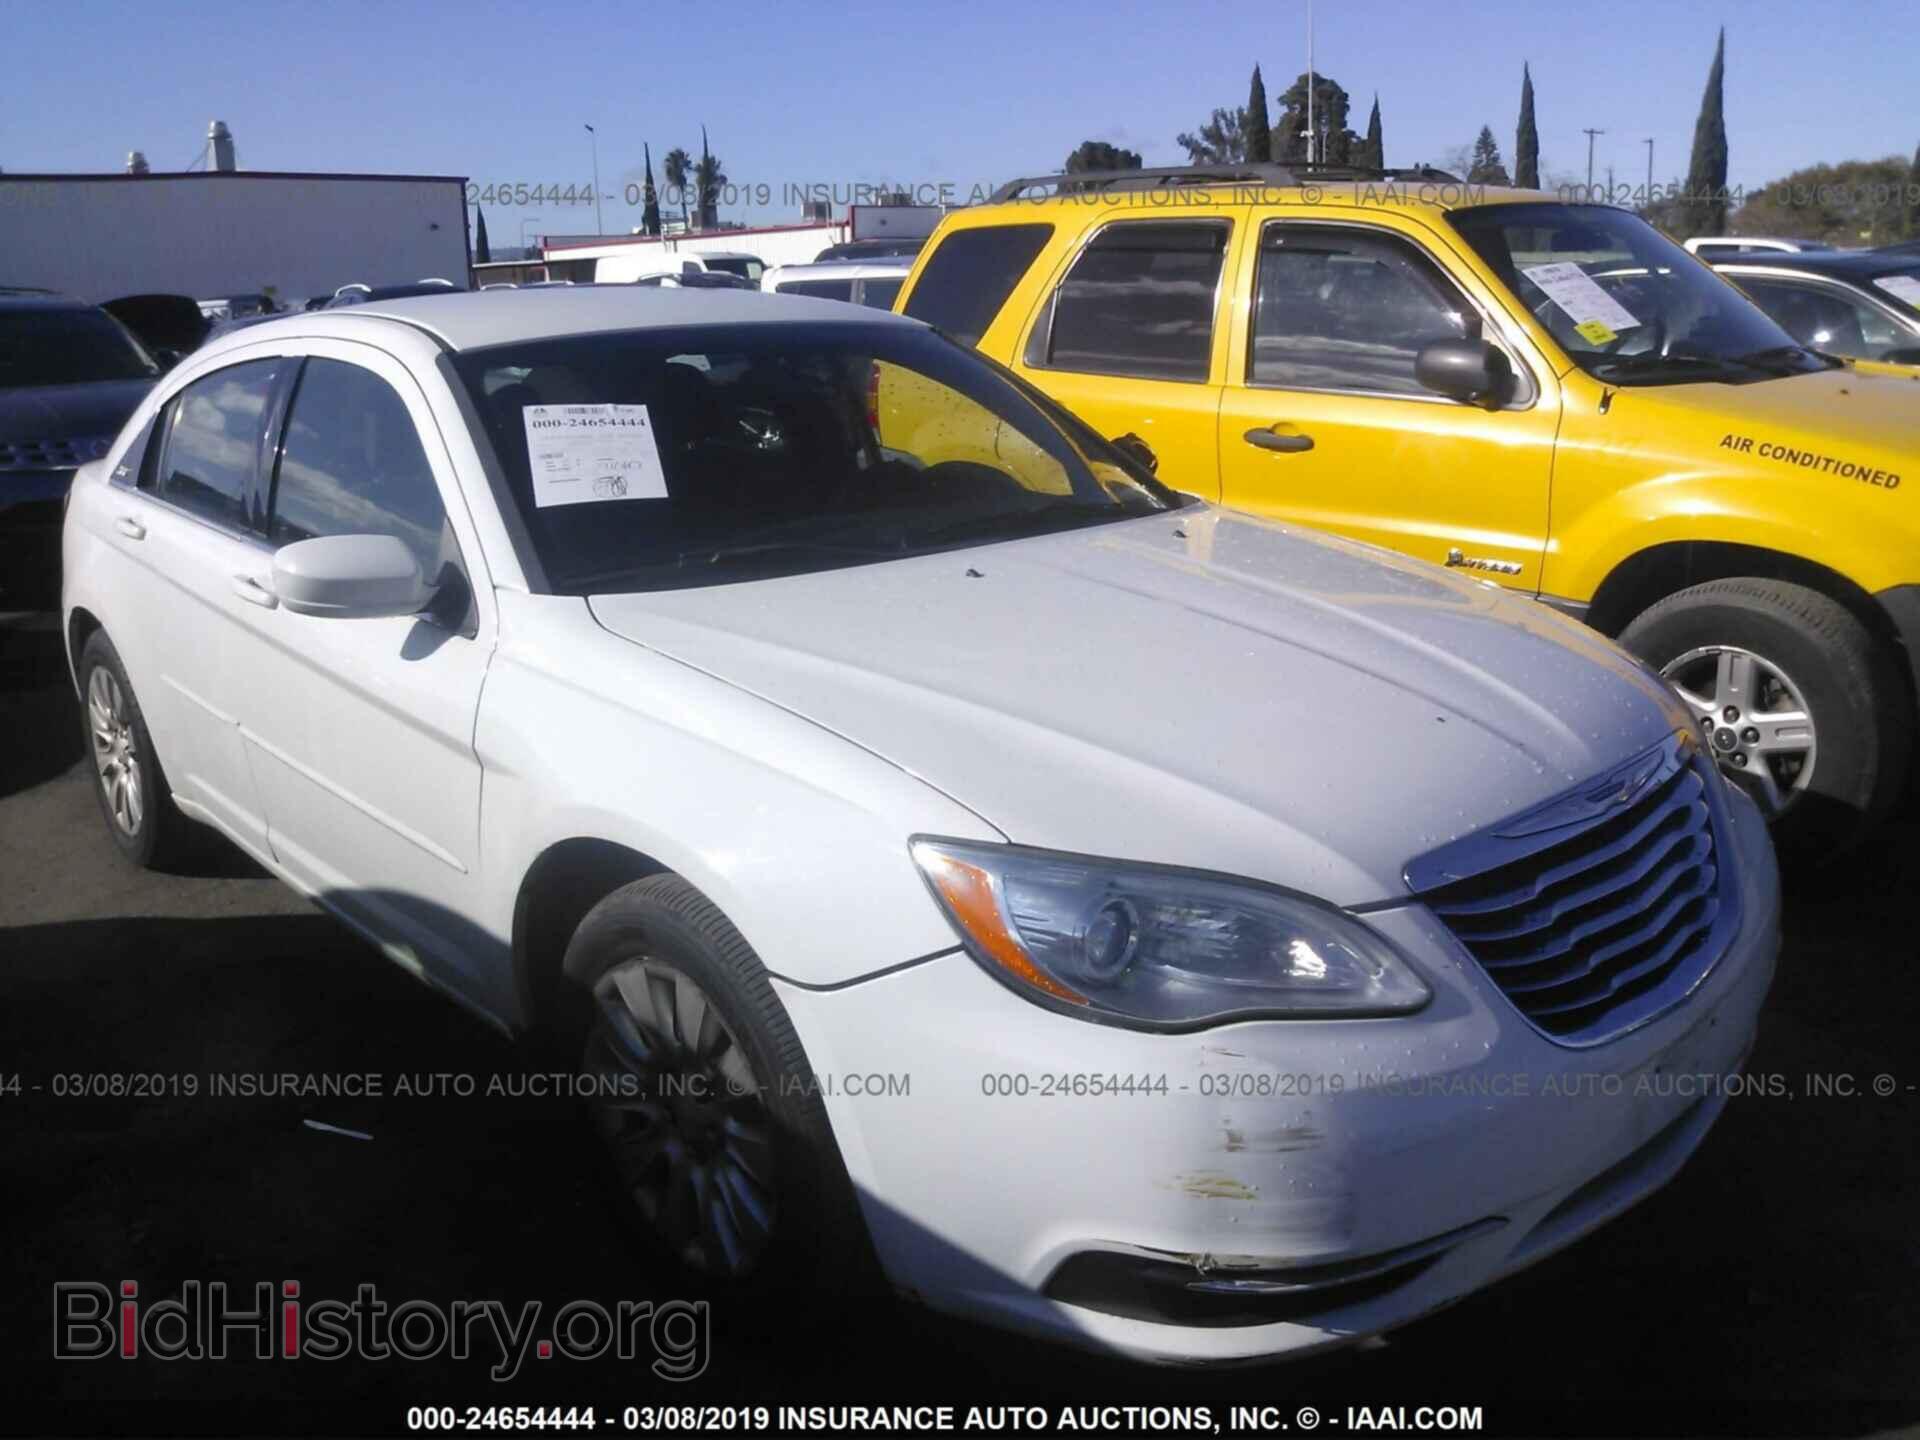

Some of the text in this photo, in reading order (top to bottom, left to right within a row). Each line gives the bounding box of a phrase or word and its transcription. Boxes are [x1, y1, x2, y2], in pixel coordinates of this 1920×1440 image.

[532, 418, 646, 429] 000-24654444
[1720, 434, 1900, 489] AIR CONDITIONED
